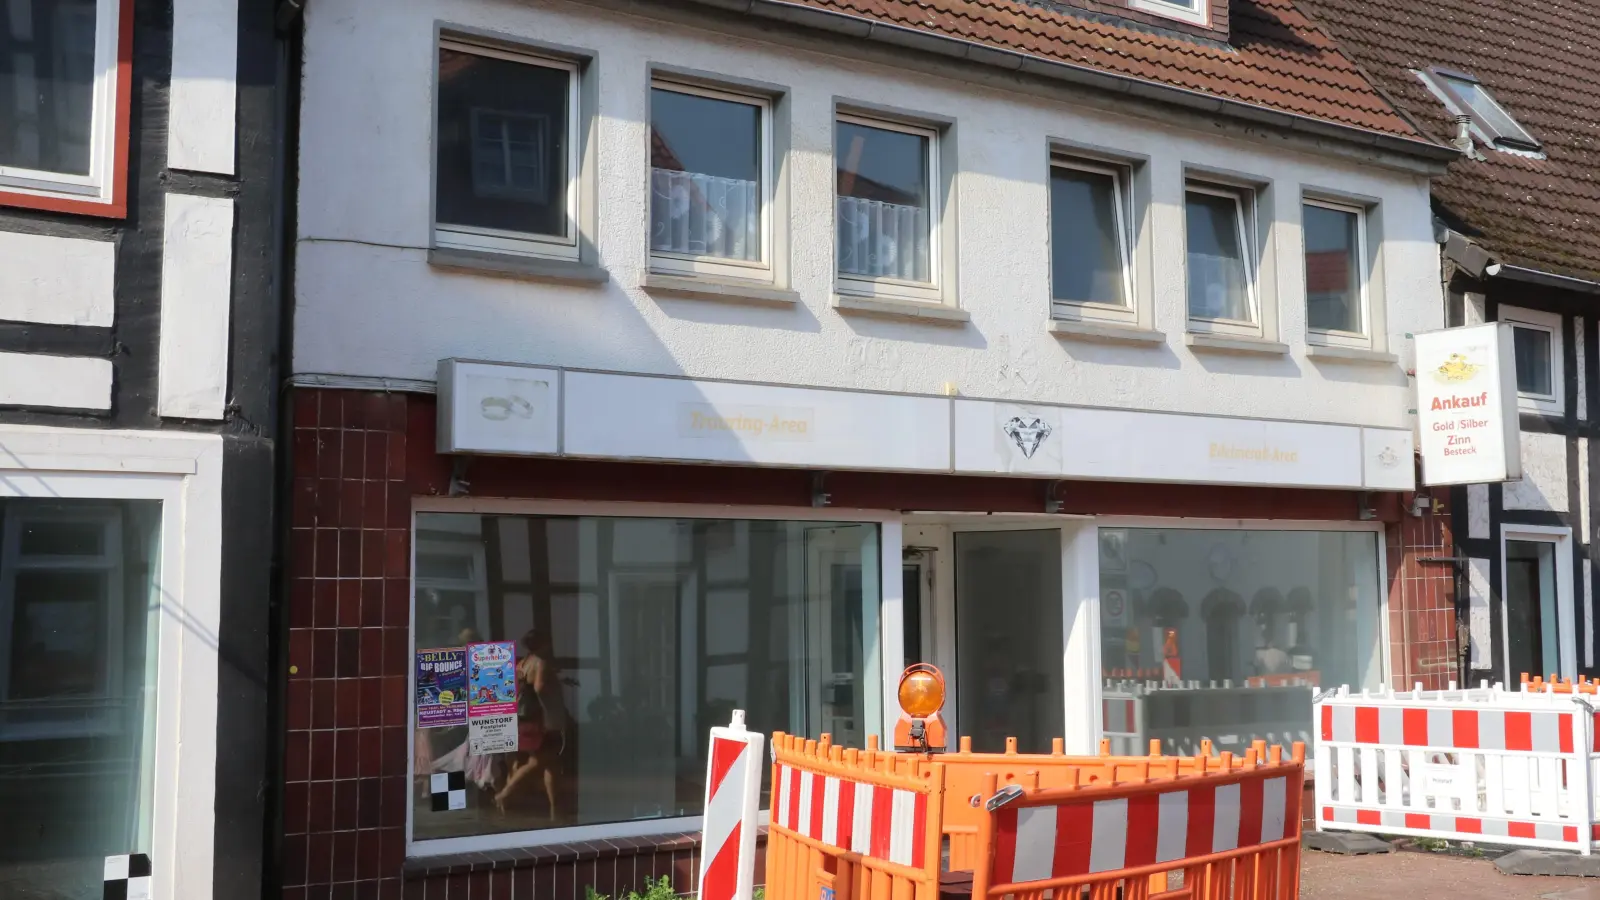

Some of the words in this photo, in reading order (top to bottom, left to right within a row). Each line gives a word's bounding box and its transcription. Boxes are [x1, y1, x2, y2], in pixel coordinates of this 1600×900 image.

[1430, 391, 1488, 411] Ankauf
[1432, 420, 1455, 432] Gold
[1447, 435, 1471, 446] Zinn
[1443, 446, 1477, 457] Besteck
[424, 652, 458, 661] BELLY
[434, 661, 462, 672] BOUNCE
[471, 717, 514, 726] WUNSTORF
